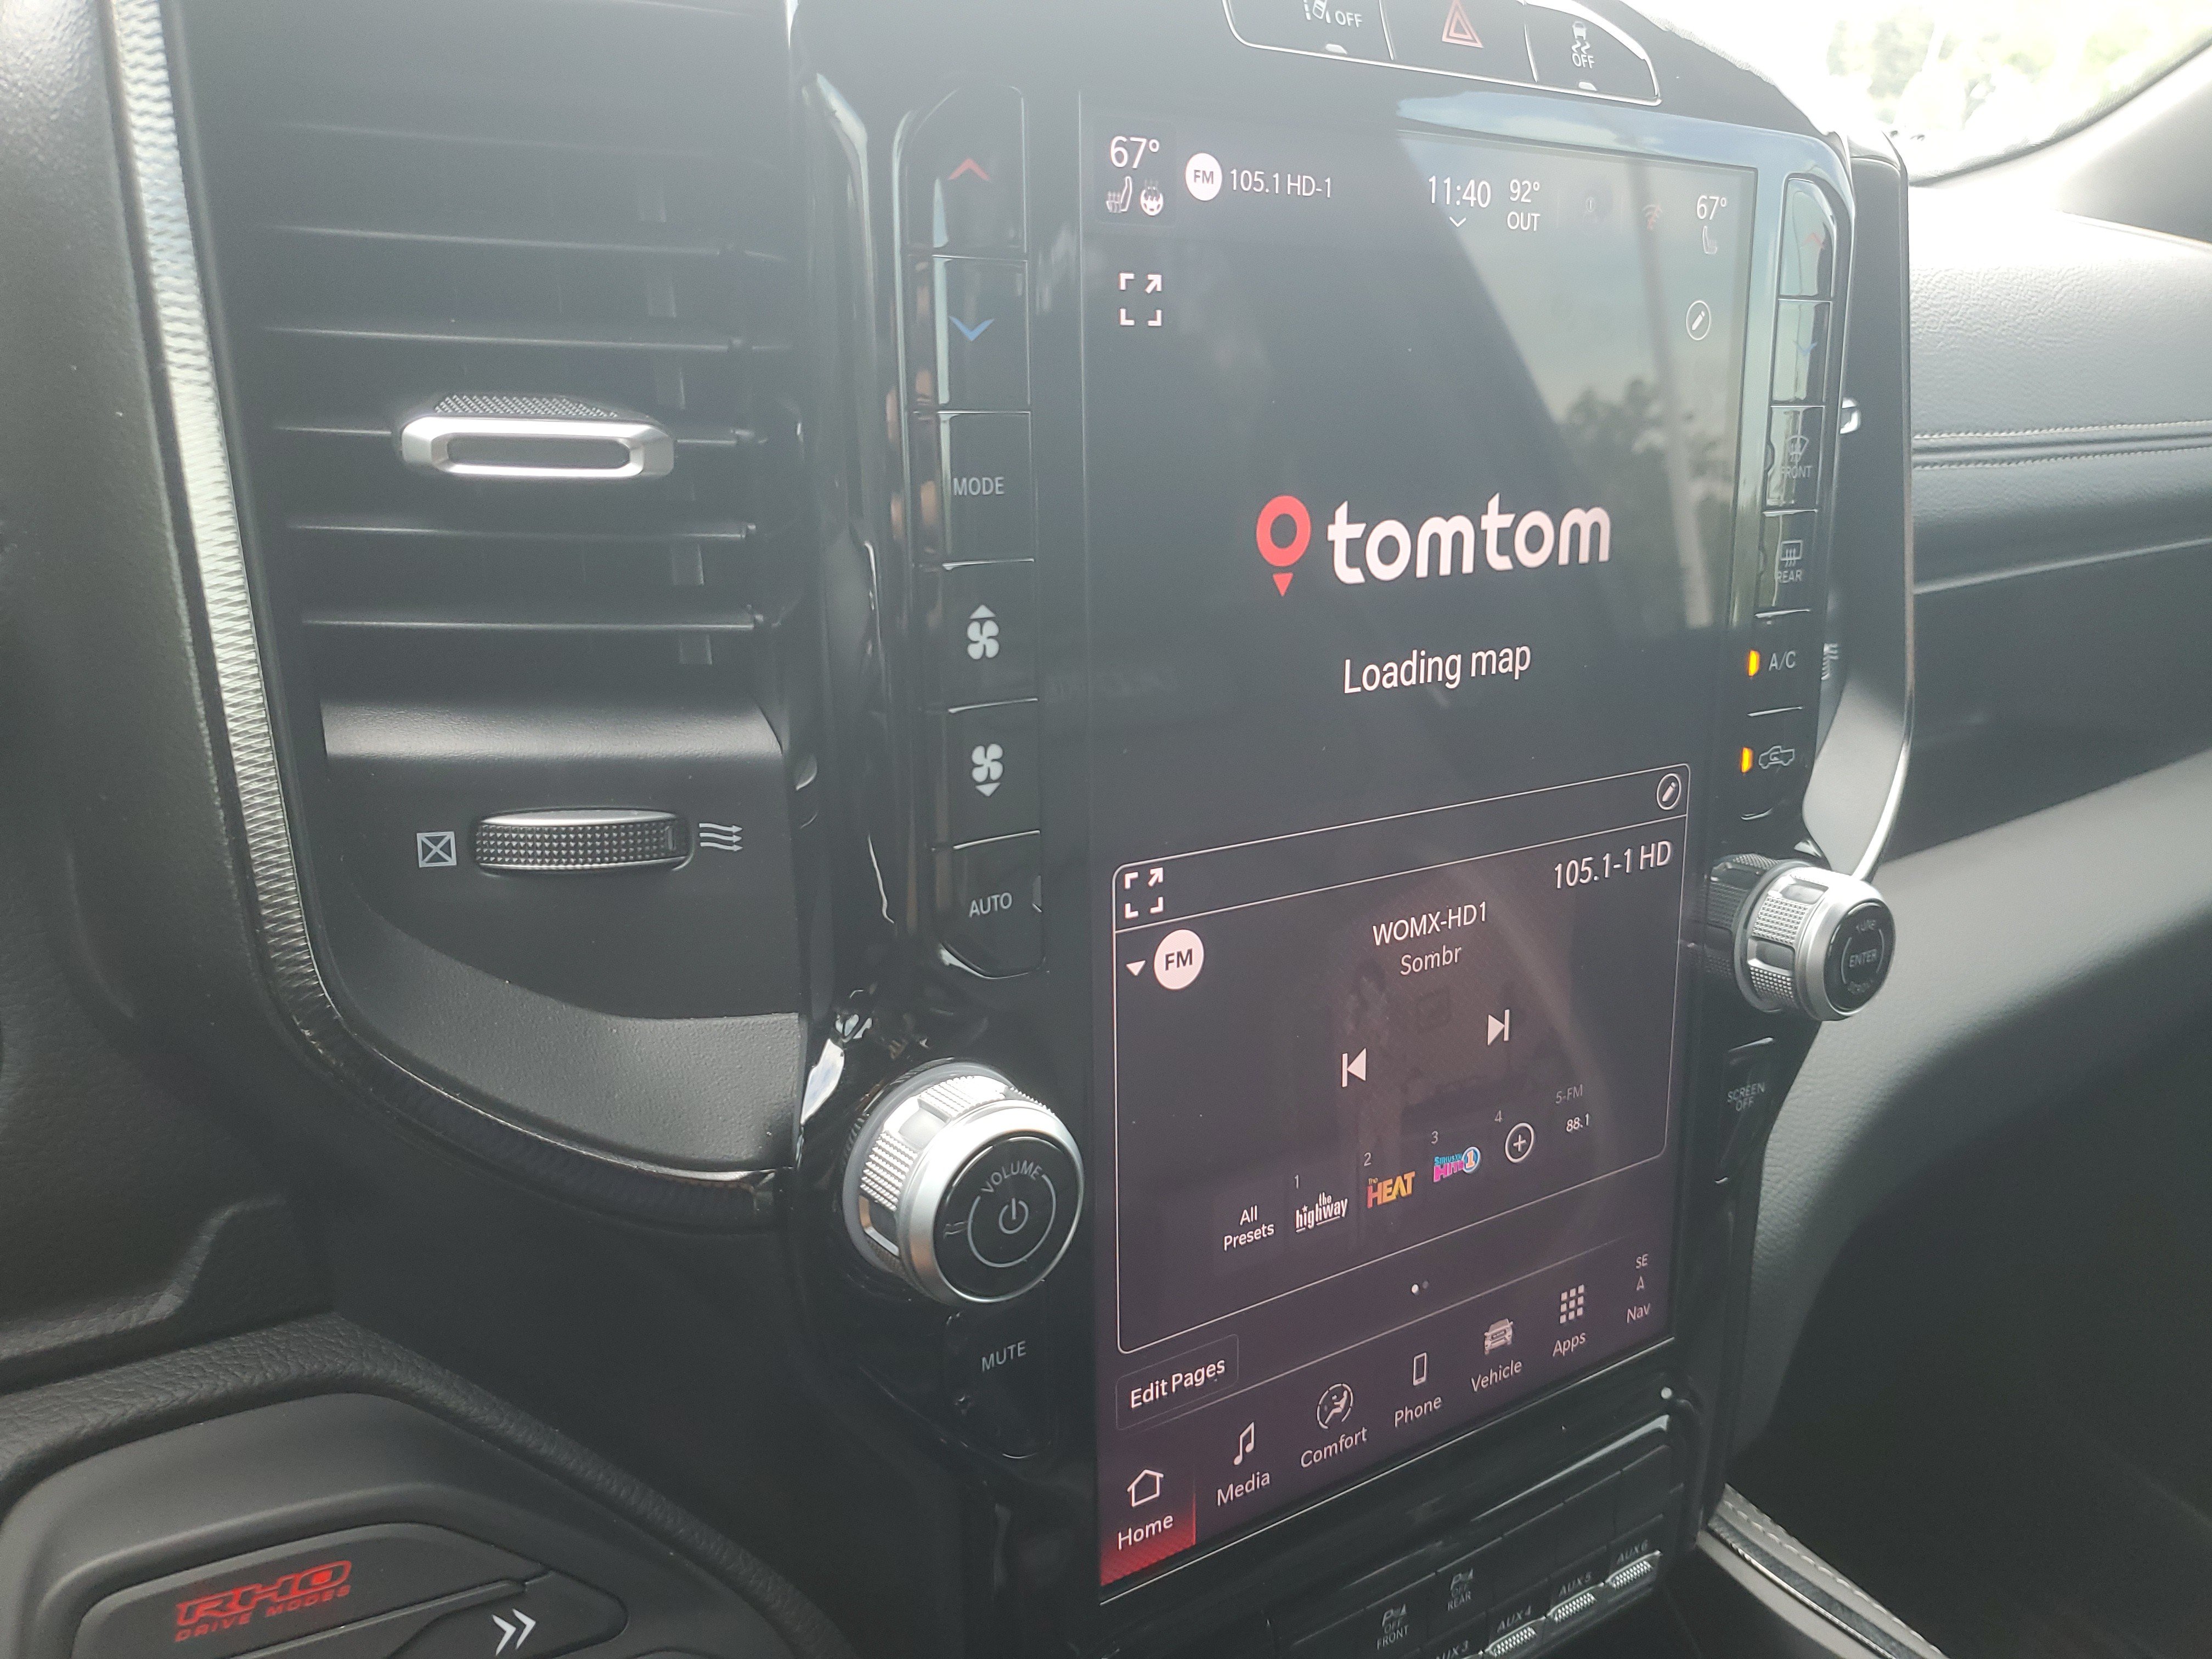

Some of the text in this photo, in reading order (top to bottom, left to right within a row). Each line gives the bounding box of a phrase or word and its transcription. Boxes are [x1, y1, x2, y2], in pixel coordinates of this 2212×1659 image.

[1334, 10, 1363, 28] OFF
[1571, 53, 1595, 69] OFF
[1110, 136, 1160, 169] 67°
[1193, 170, 1215, 185] FM
[1229, 168, 1332, 199] 105.1 HD-1
[1428, 176, 1491, 208] 11:40
[1509, 179, 1541, 204] 92°
[1506, 211, 1541, 232] OUT
[1782, 465, 1812, 479] FRONT
[953, 476, 1005, 496] MODE
[1327, 492, 1611, 585] tomtom
[1777, 569, 1803, 584] REAR
[1344, 645, 1531, 694] Loading map
[1769, 650, 1796, 672] A/C
[1554, 840, 1672, 889] 105.1-1 HD
[968, 891, 1013, 918] AUTO
[1372, 901, 1487, 946] WOMX-HD1
[1164, 947, 1193, 972] FM
[1400, 944, 1462, 976] Sombr
[1849, 949, 1877, 968] ENTER
[1555, 1084, 1583, 1104] 5-FM
[1727, 1082, 1765, 1103] SCREEN
[1735, 1096, 1754, 1112] OFF
[1494, 1109, 1503, 1123] 4
[1566, 1113, 1590, 1133] 88.1
[1431, 1130, 1439, 1145] 3
[1363, 1152, 1372, 1167] 2
[980, 1159, 1043, 1193] VOLUME
[1294, 1174, 1300, 1189] 1
[1318, 1192, 1332, 1207] the
[1367, 1170, 1415, 1209] HEAT
[1239, 1205, 1258, 1226] All
[1295, 1198, 1348, 1230] highway
[1223, 1223, 1275, 1251] Presets
[1635, 1253, 1649, 1269] SE
[1627, 1302, 1651, 1324] Nav
[981, 1340, 1027, 1372] MUTE
[1552, 1330, 1587, 1358] Apps
[1130, 1358, 1226, 1409] Edit Pages
[1471, 1359, 1523, 1392] Vehicle
[1394, 1395, 1443, 1428] Phone
[1300, 1426, 1368, 1469] Comfort
[1216, 1470, 1271, 1507] Media
[1117, 1514, 1174, 1551] Home
[1559, 1576, 1583, 1598] AUX
[1447, 1590, 1471, 1611] REAR
[174, 1584, 351, 1642] DRIVE MODES
[1497, 1609, 1523, 1633] AUX
[1376, 1624, 1409, 1651] FRONT
[1435, 1645, 1459, 1659] UX
